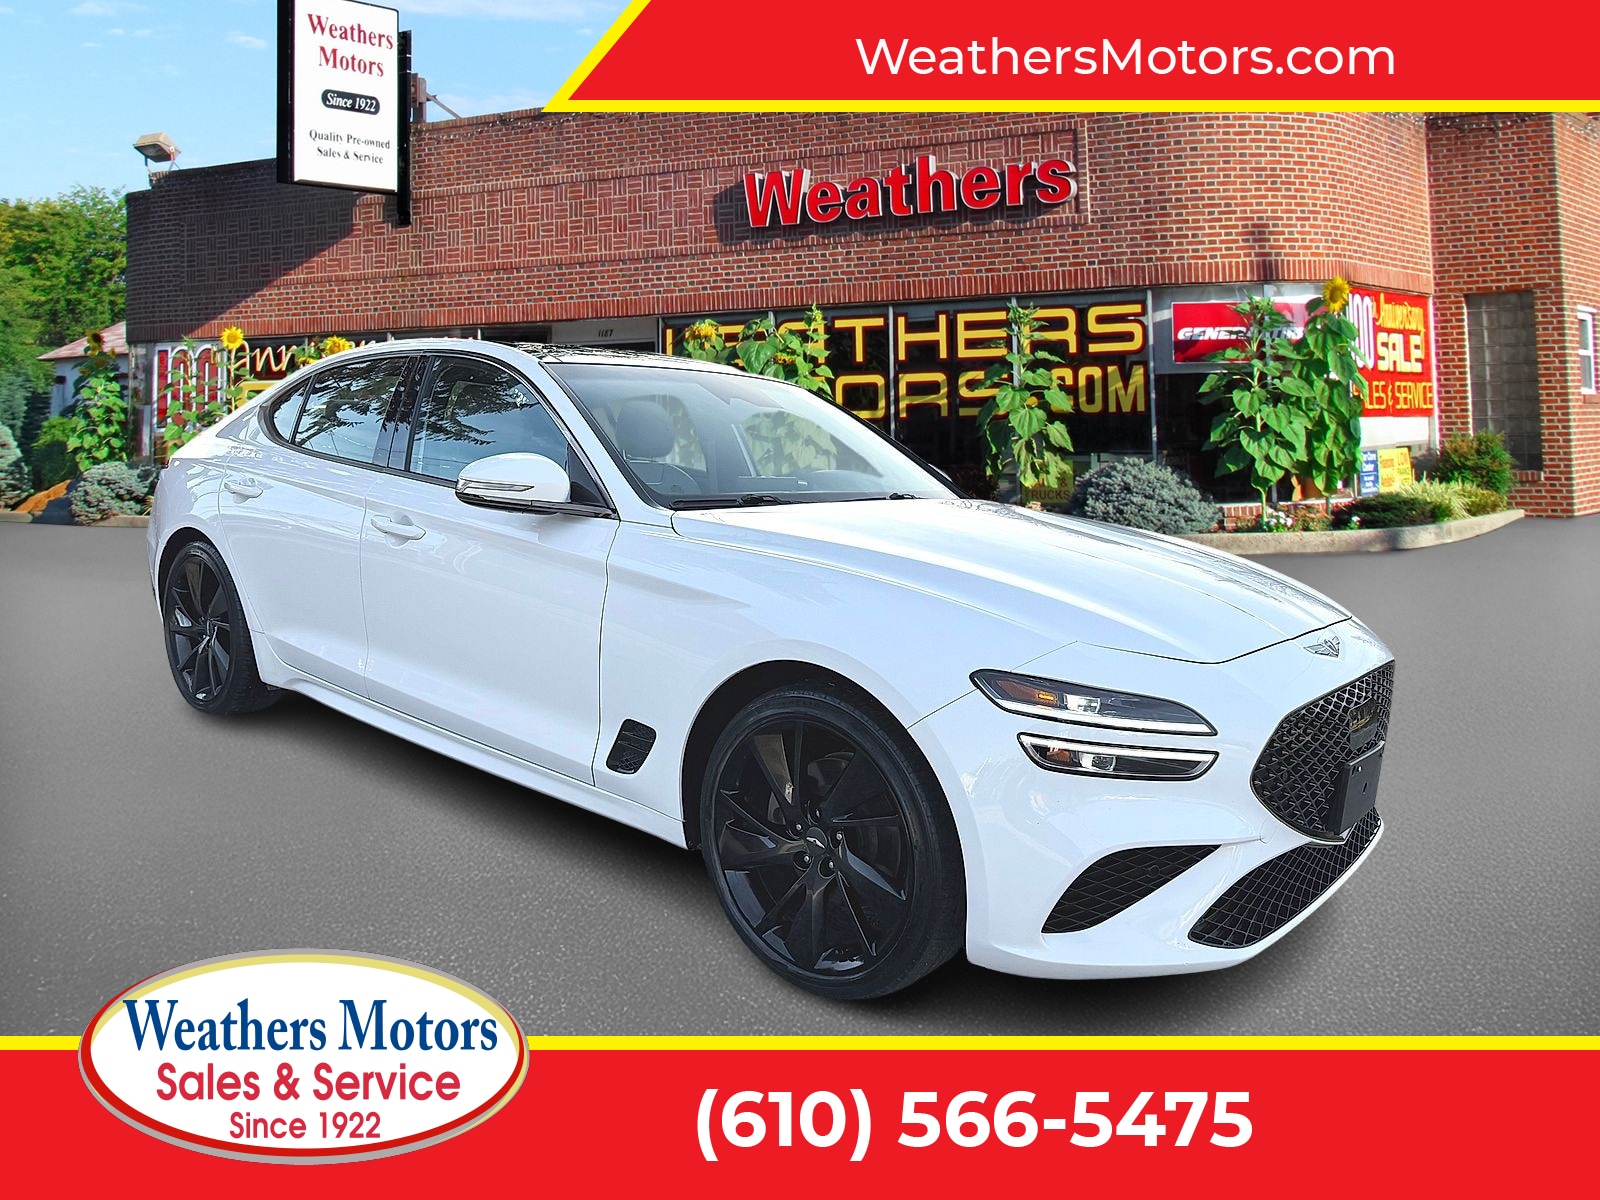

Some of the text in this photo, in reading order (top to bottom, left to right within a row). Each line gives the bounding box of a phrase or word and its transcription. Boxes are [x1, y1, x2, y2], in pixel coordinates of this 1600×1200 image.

[307, 13, 394, 50] Weathers
[319, 46, 384, 77] Motors
[326, 92, 376, 112] Since 1922
[309, 129, 391, 150] Quality Pre-owned
[317, 146, 384, 164] Sales & Service
[743, 154, 1077, 228] Weathers
[598, 329, 613, 338] 1187
[1376, 332, 1423, 373] SALE
[1395, 382, 1434, 409] SERVICE
